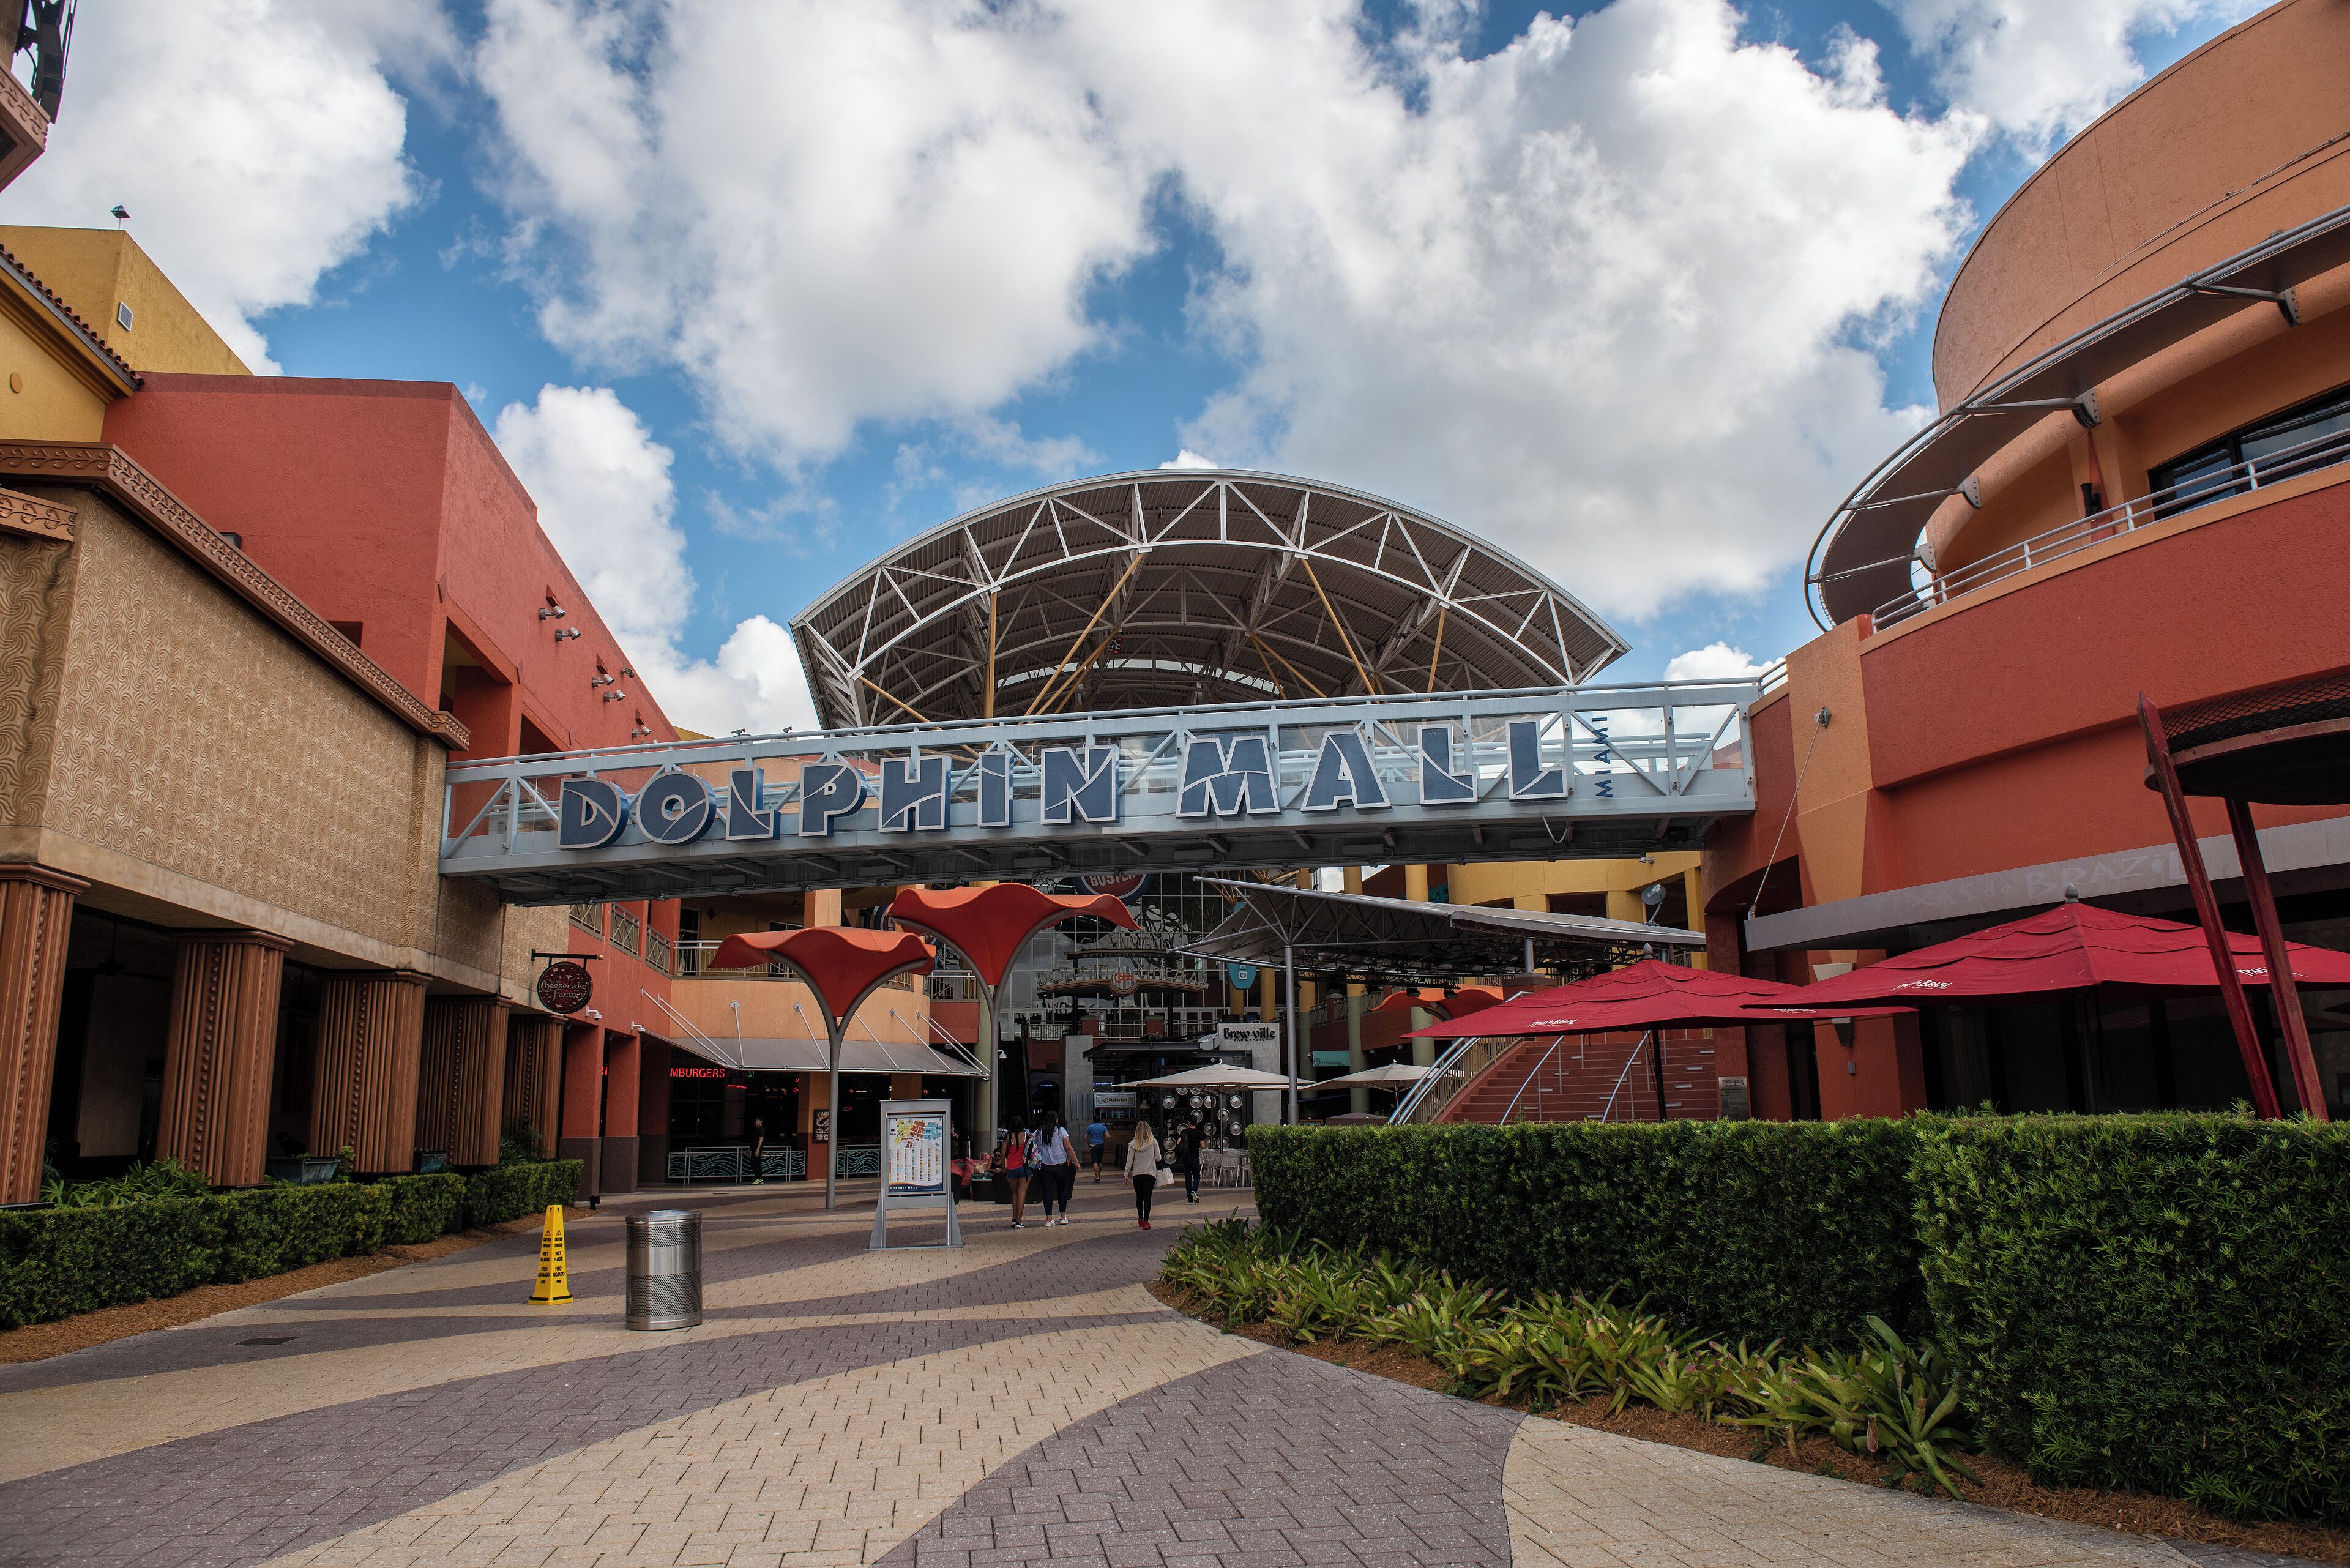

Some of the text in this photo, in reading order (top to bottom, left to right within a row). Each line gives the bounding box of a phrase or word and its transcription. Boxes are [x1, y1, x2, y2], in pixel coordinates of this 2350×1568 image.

[1591, 717, 1613, 797] MIAMI
[556, 719, 1569, 850] DOLPHIN MALL
[1089, 873, 1142, 887] BUSTE
[1037, 965, 1208, 986] DOLPHIN CINEMAS
[541, 980, 587, 992] Cheesecake
[550, 989, 586, 1001] Factory
[670, 1068, 725, 1077] MBURGERS
